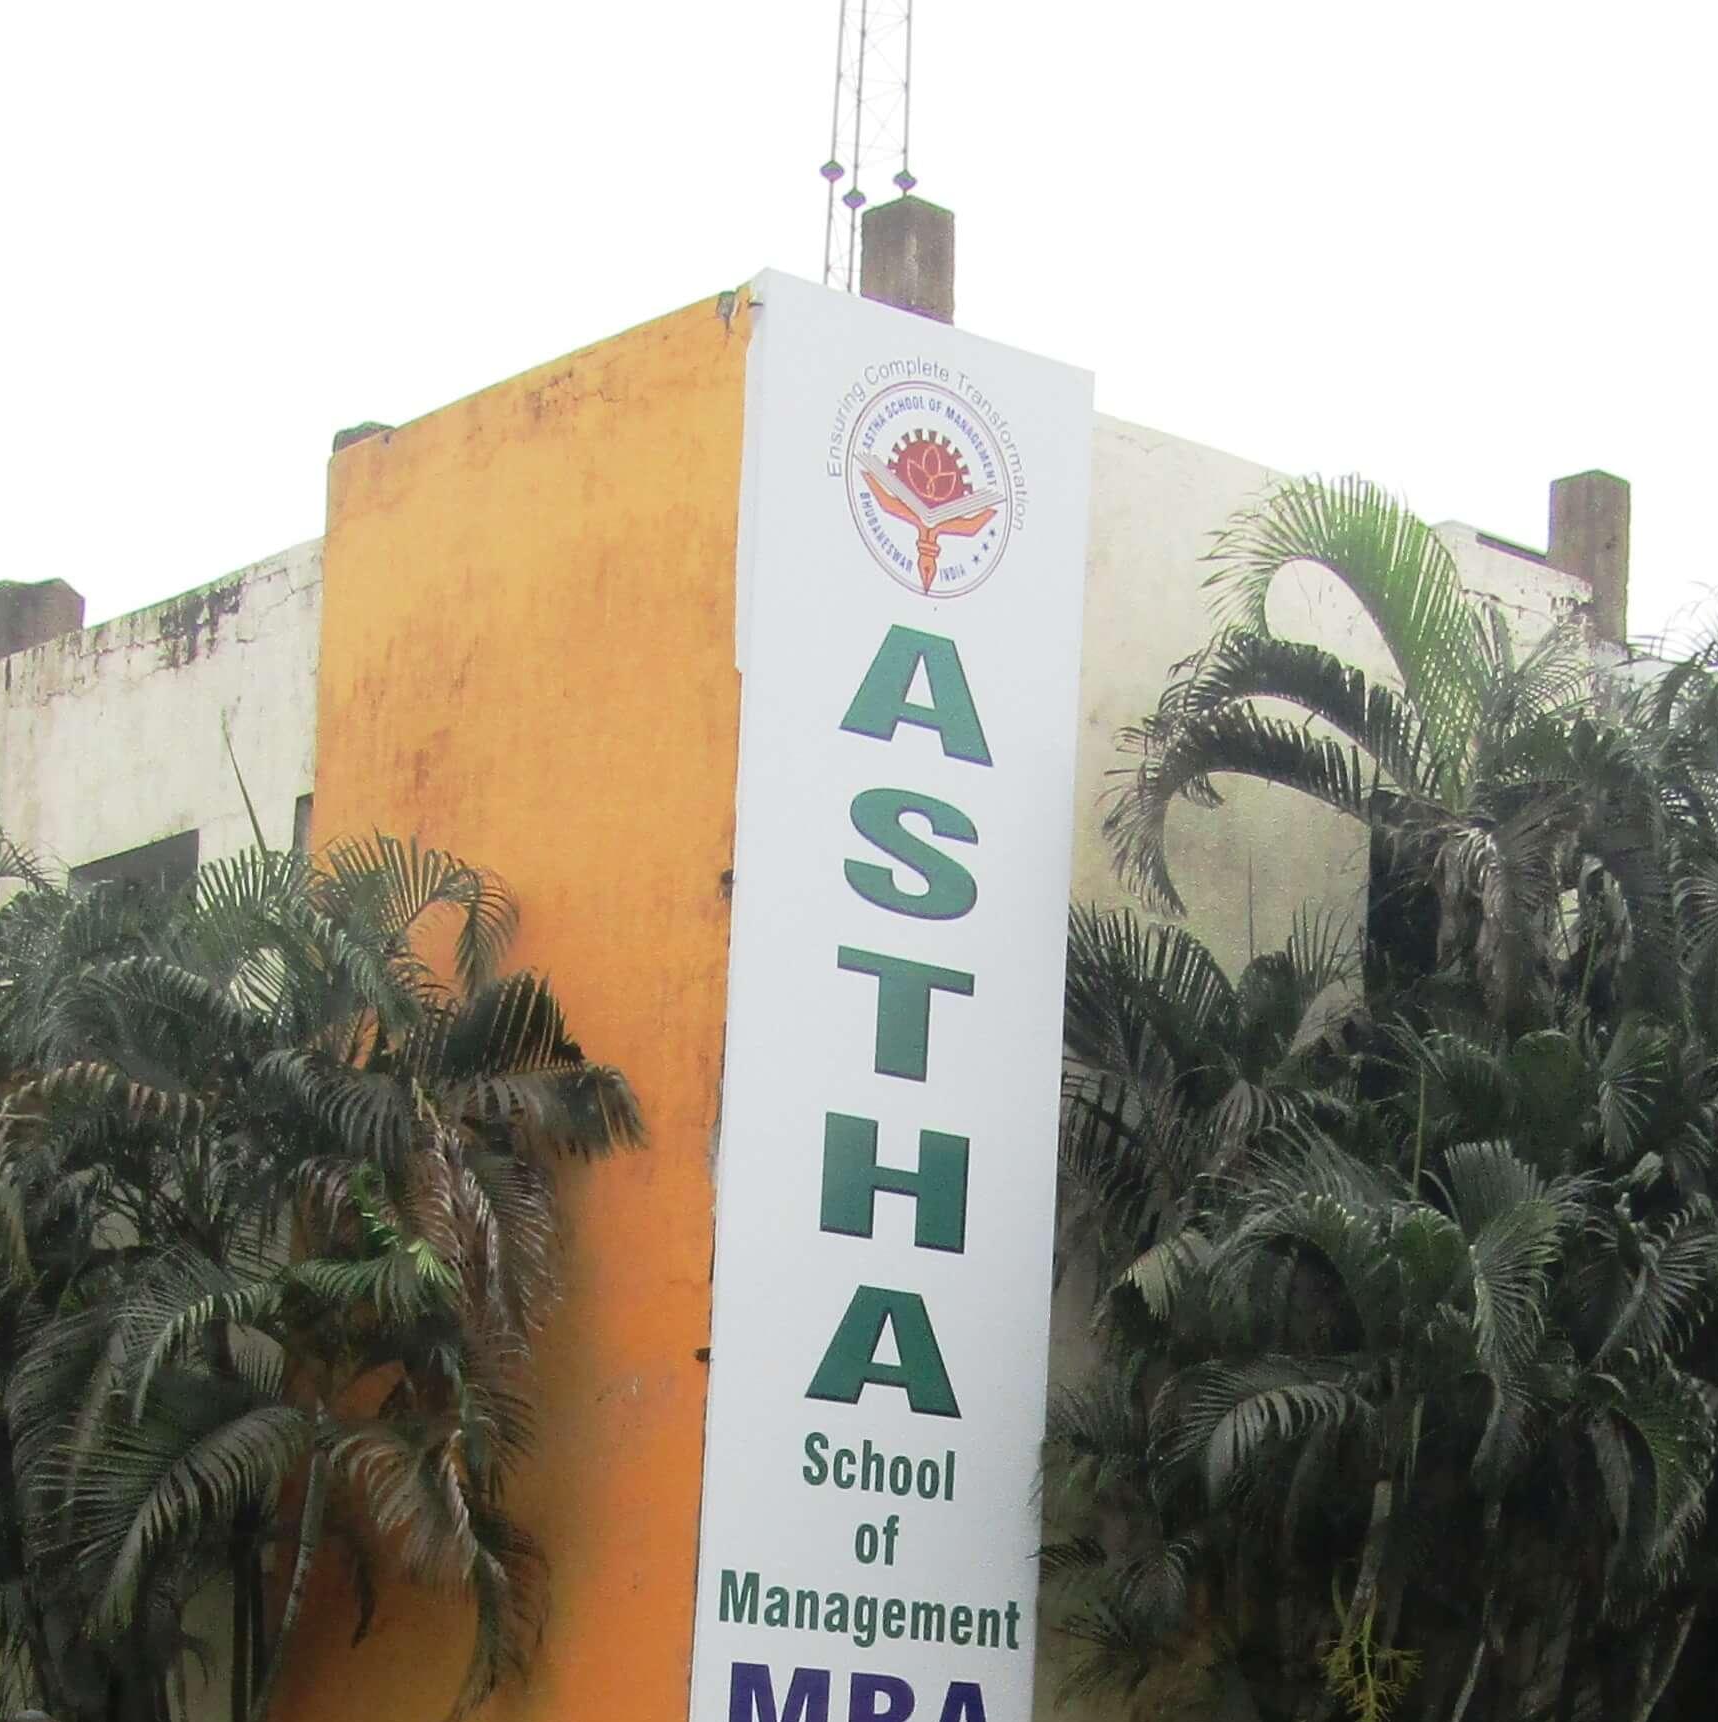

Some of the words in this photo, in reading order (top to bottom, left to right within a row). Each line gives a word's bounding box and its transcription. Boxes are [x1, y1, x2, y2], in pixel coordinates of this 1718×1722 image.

[827, 382, 867, 477] Ensuring
[864, 356, 949, 385] Complete
[957, 372, 1029, 532] Transformation
[862, 413, 888, 450] ASTHA
[884, 395, 925, 419] SCHOOL
[929, 397, 943, 411] OF
[944, 405, 998, 487] MANAGEMENT
[939, 563, 967, 582] INDIA
[805, 625, 992, 1419] ASTHA
[802, 1432, 956, 1501] School
[855, 1515, 899, 1566] of
[719, 1570, 1021, 1651] Management
